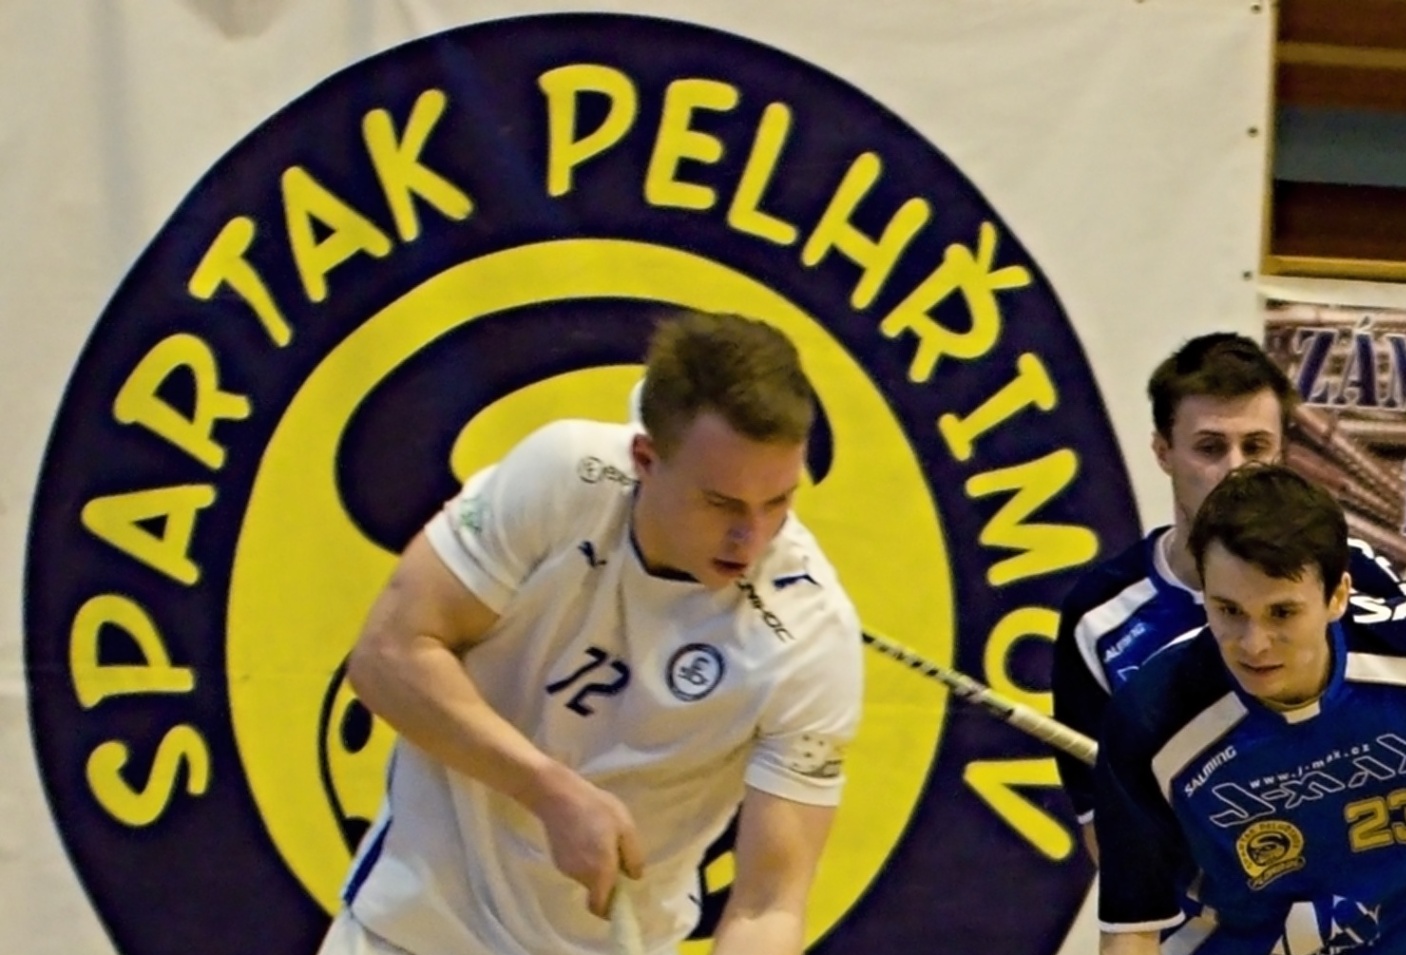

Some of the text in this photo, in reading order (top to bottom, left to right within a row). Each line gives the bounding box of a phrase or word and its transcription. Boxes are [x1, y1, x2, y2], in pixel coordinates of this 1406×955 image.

[70, 63, 1099, 861] SPARTAK PELHŘIMOV
[1184, 745, 1237, 798] SALMING
